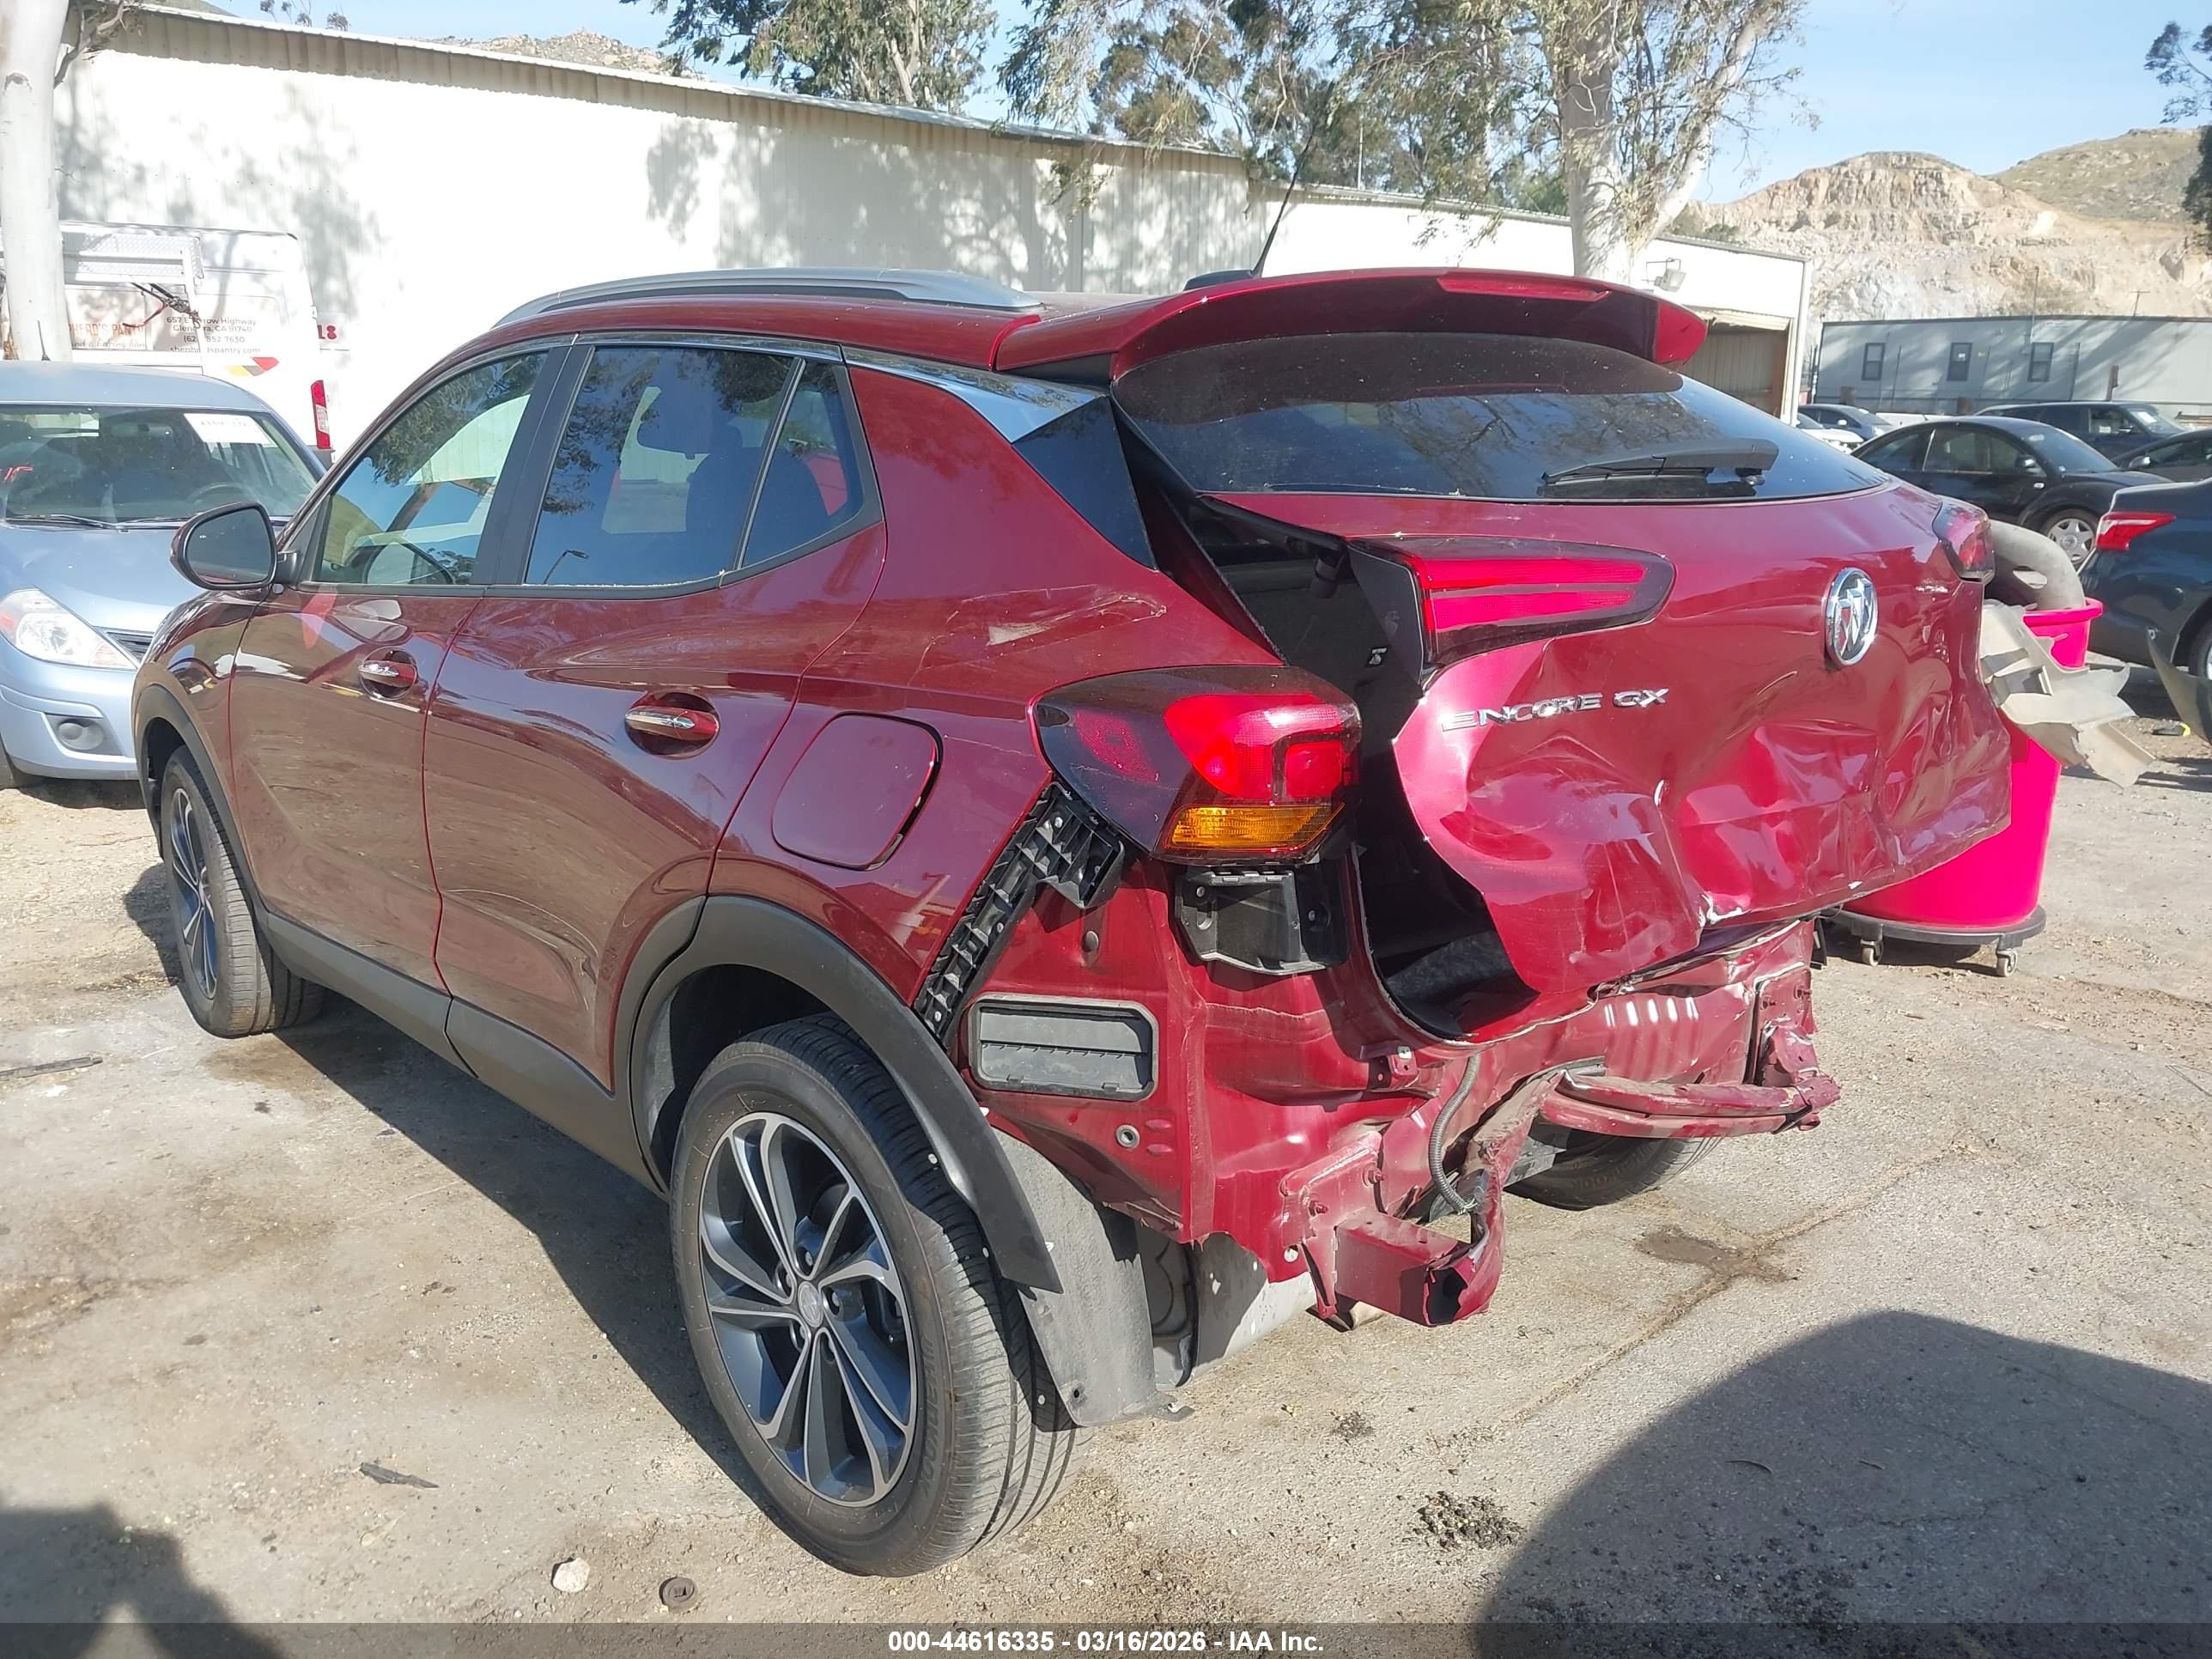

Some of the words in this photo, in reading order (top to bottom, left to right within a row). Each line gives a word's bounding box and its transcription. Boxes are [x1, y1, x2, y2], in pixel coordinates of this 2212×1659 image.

[221, 317, 257, 326] Highway
[1442, 692, 1603, 732] ENCORE
[1613, 688, 1669, 708] GX
